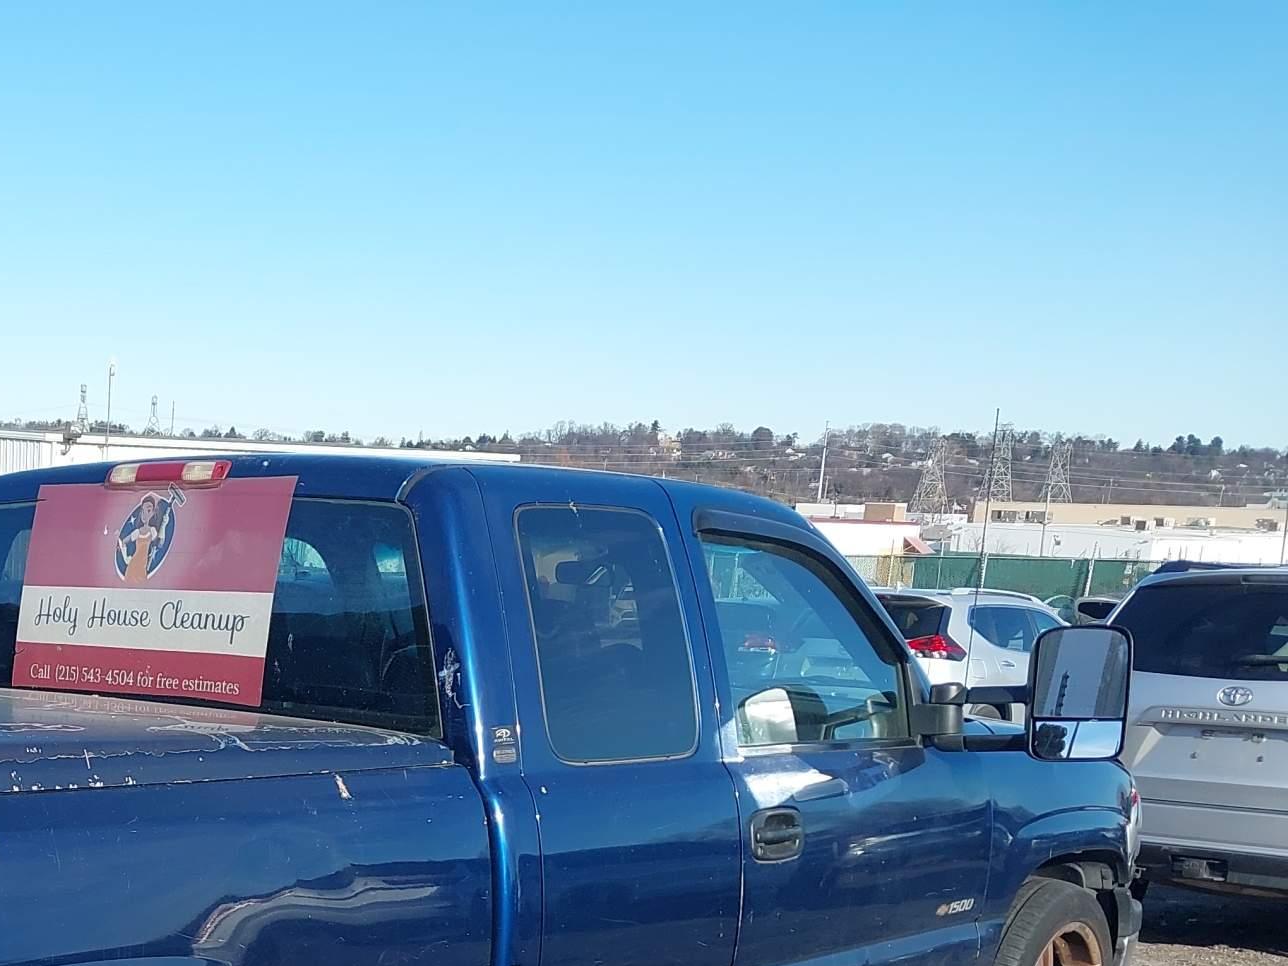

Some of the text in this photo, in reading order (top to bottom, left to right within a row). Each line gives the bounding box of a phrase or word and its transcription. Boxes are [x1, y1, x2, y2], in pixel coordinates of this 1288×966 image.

[34, 595, 250, 645] Holy House Cleanup
[30, 663, 240, 696] Call (215) 543-4504 for free estimates
[948, 898, 974, 914] 1500
